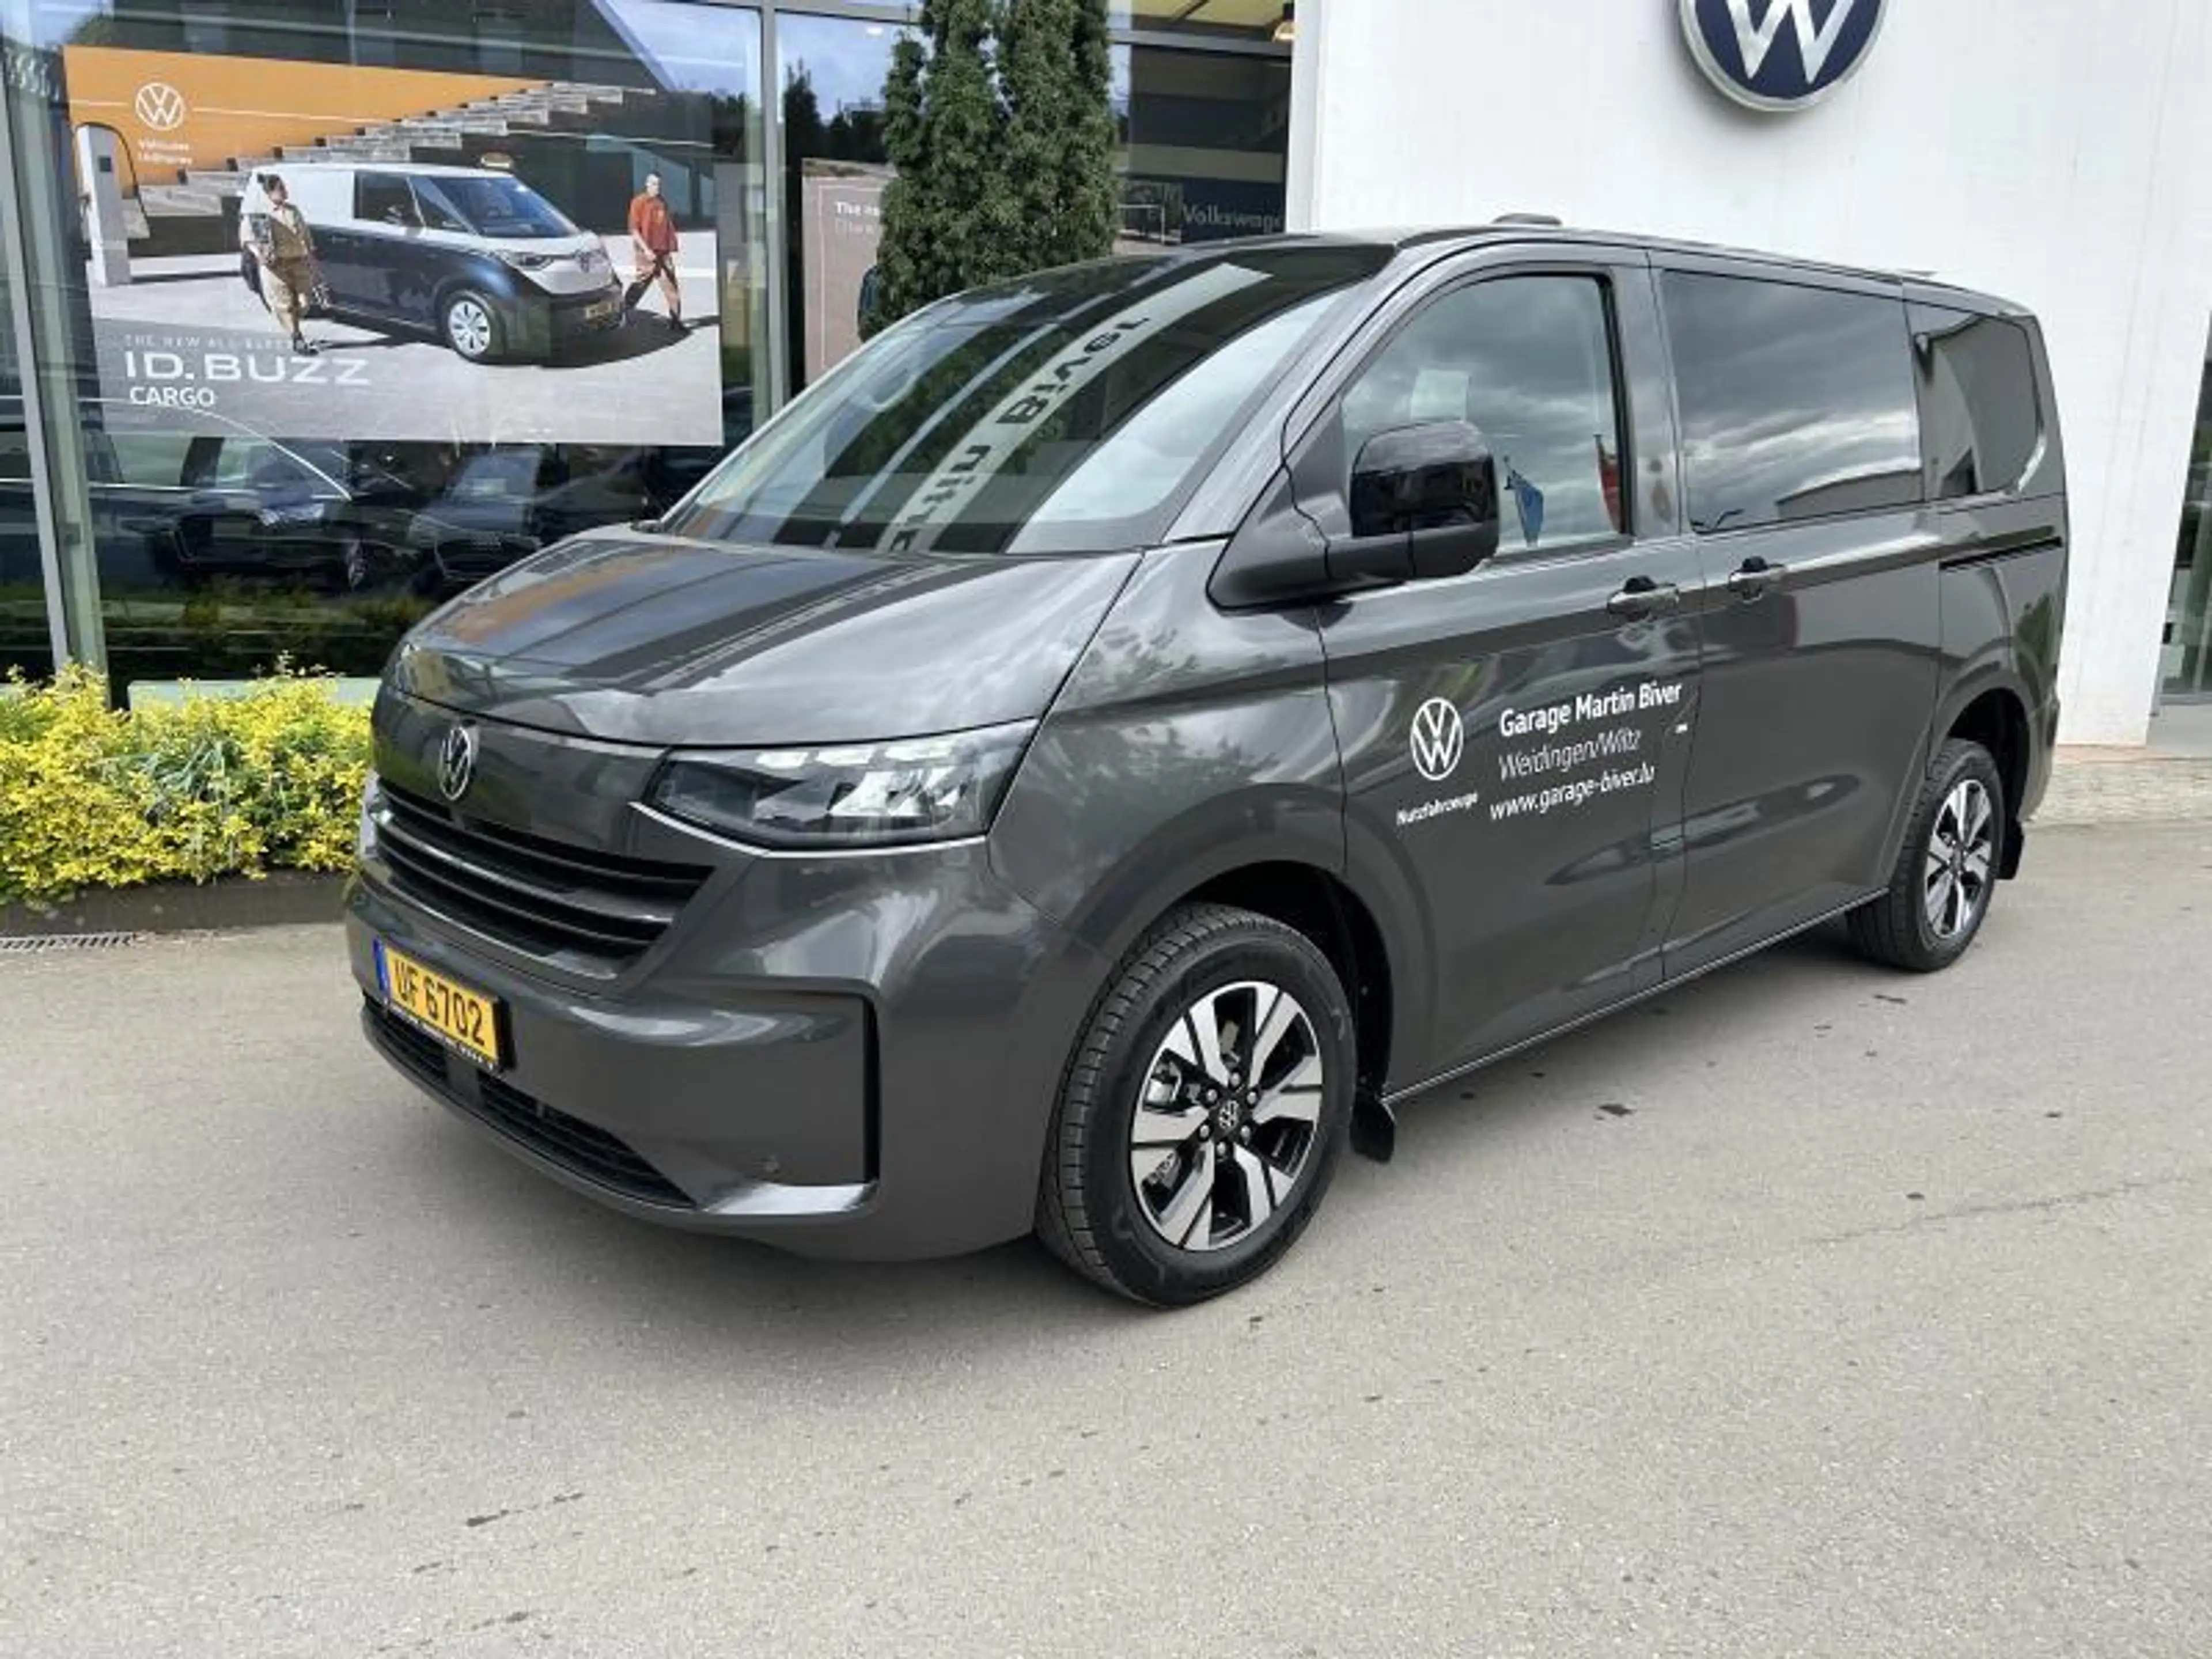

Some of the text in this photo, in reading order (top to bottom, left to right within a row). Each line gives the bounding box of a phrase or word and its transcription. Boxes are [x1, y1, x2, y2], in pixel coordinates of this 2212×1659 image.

[1182, 204, 1283, 235] Volkswage
[130, 387, 215, 407] CARGO
[1500, 680, 1683, 737] Garage Martin Biver
[423, 976, 486, 1047] 6702
